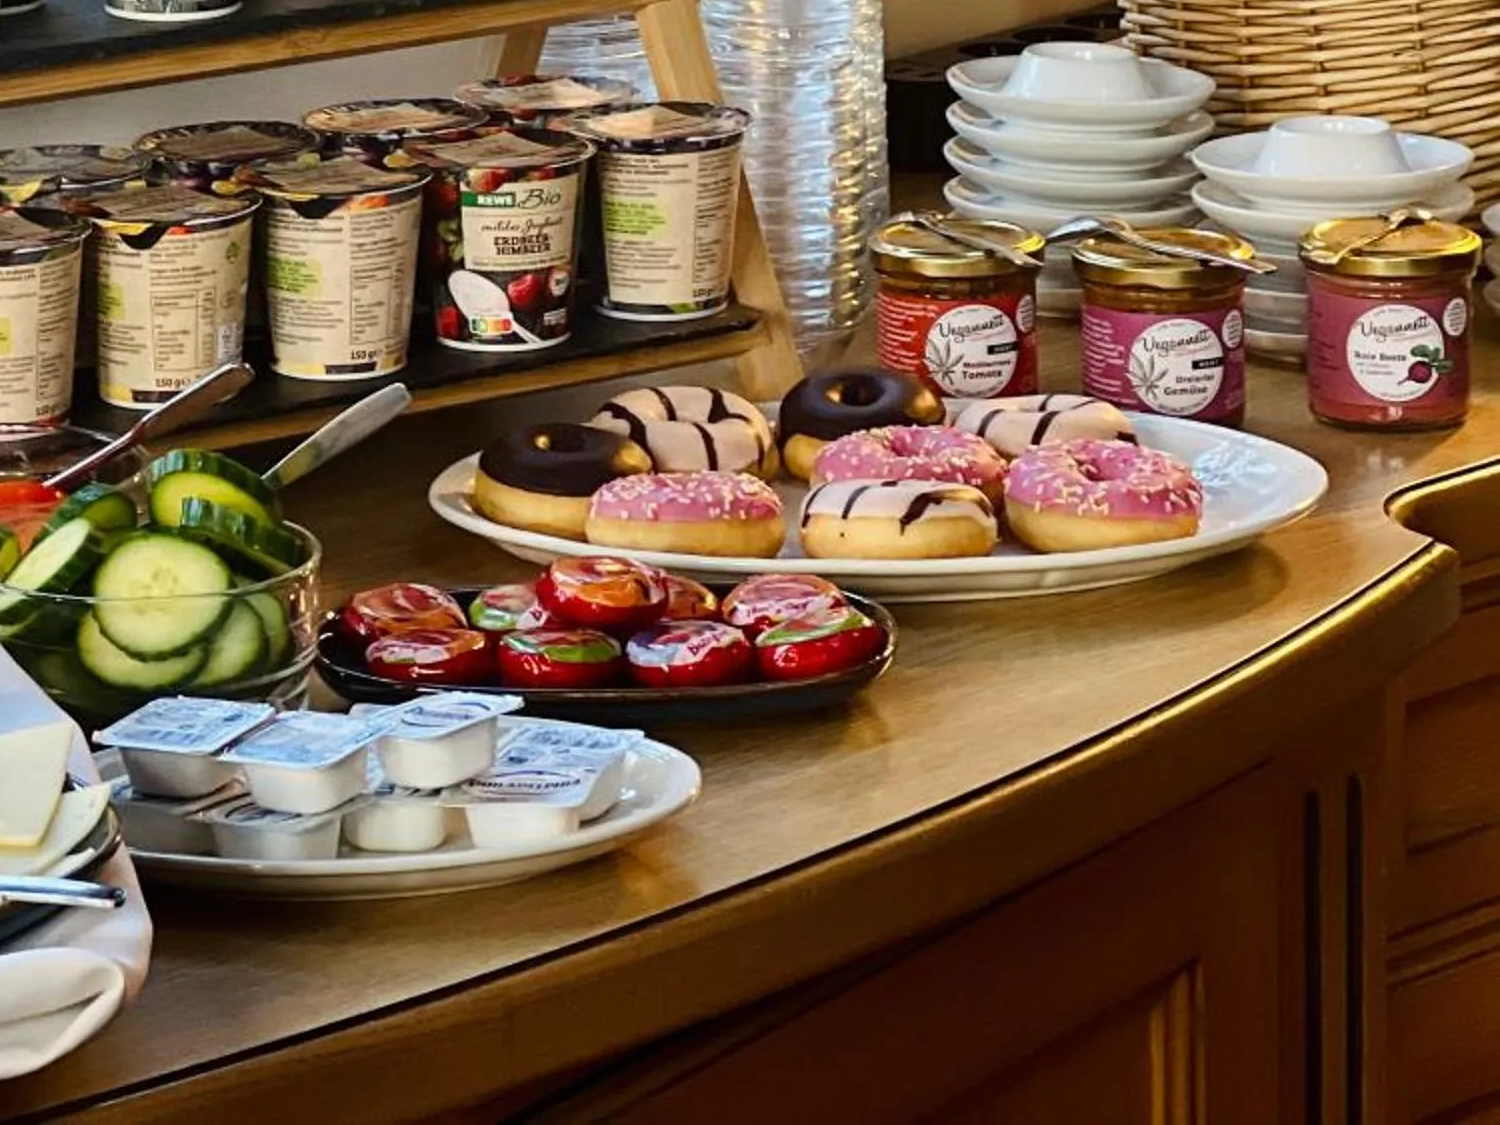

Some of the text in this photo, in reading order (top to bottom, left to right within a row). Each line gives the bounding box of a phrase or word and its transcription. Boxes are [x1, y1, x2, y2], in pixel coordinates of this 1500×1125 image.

[477, 188, 562, 209] REWE Bio
[962, 369, 1003, 380] Tomate
[155, 378, 172, 388] 150
